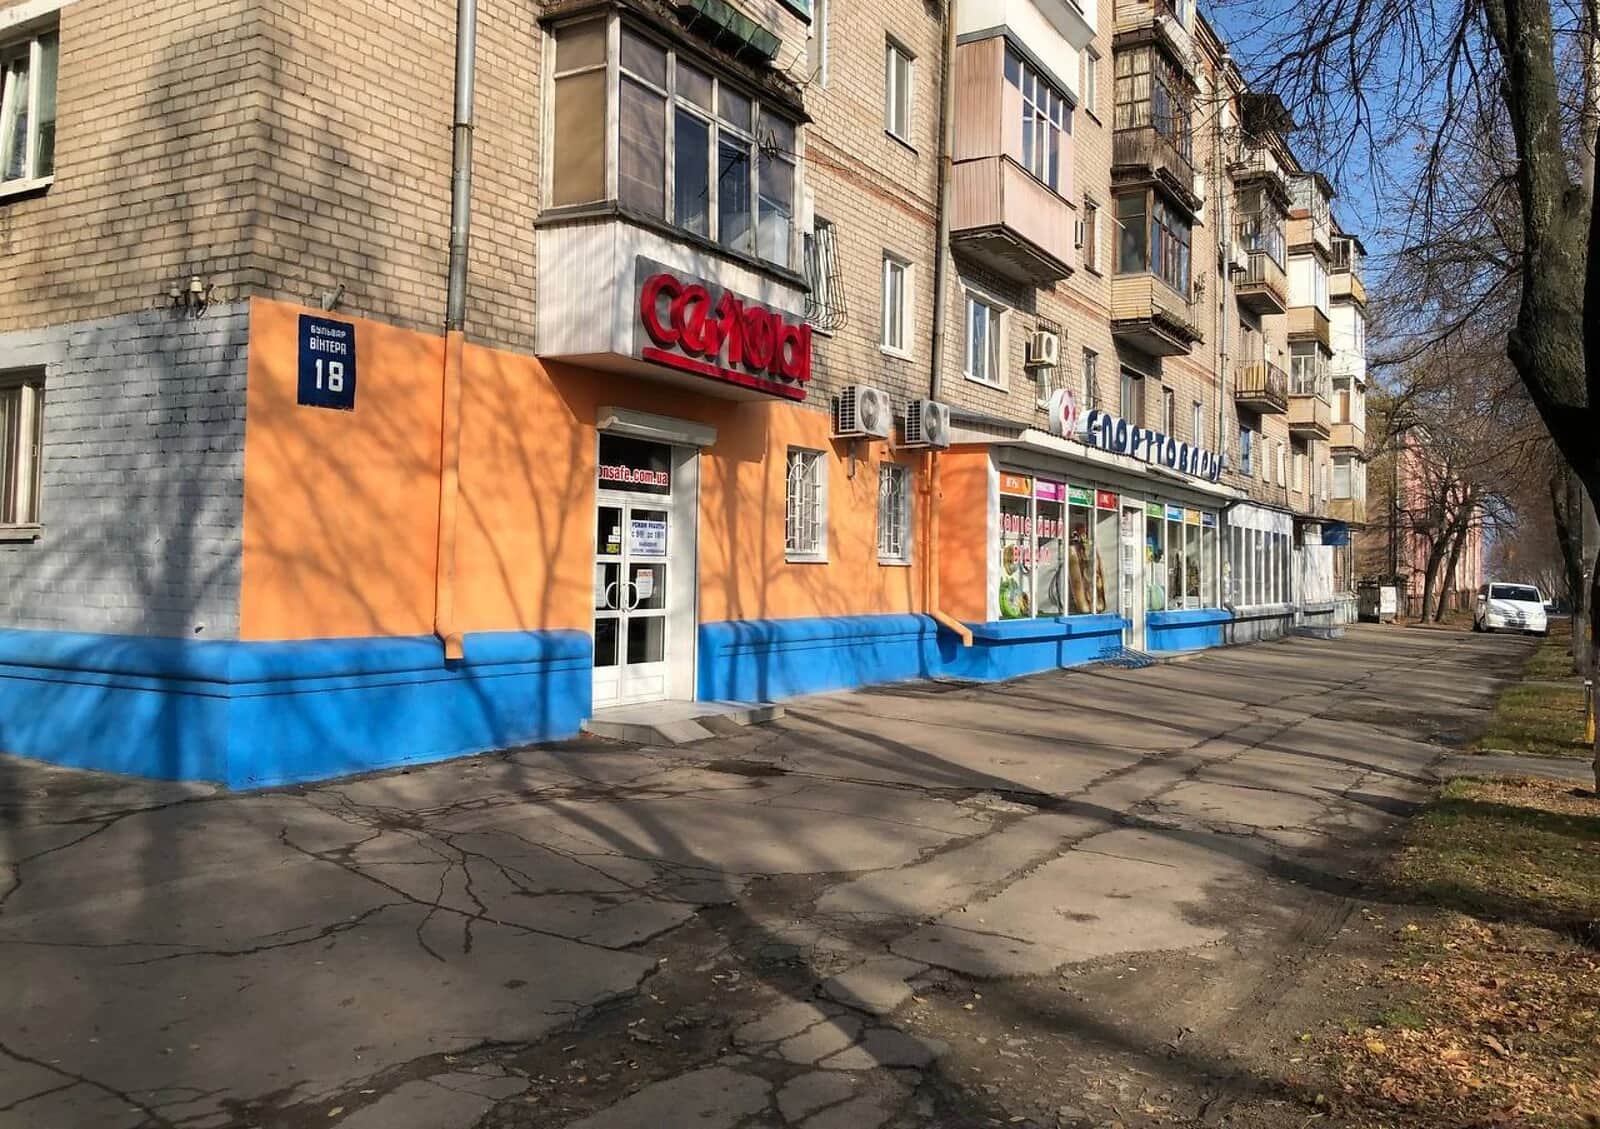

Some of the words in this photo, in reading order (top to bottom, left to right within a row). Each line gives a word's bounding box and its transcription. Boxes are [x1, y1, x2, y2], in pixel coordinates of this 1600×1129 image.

[310, 324, 347, 339] БУЛЬВАР
[315, 358, 344, 392] 18
[1087, 409, 1223, 482] СПОРТТОВАРЫ
[1000, 512, 1064, 538] ОМІСЙНИЙ
